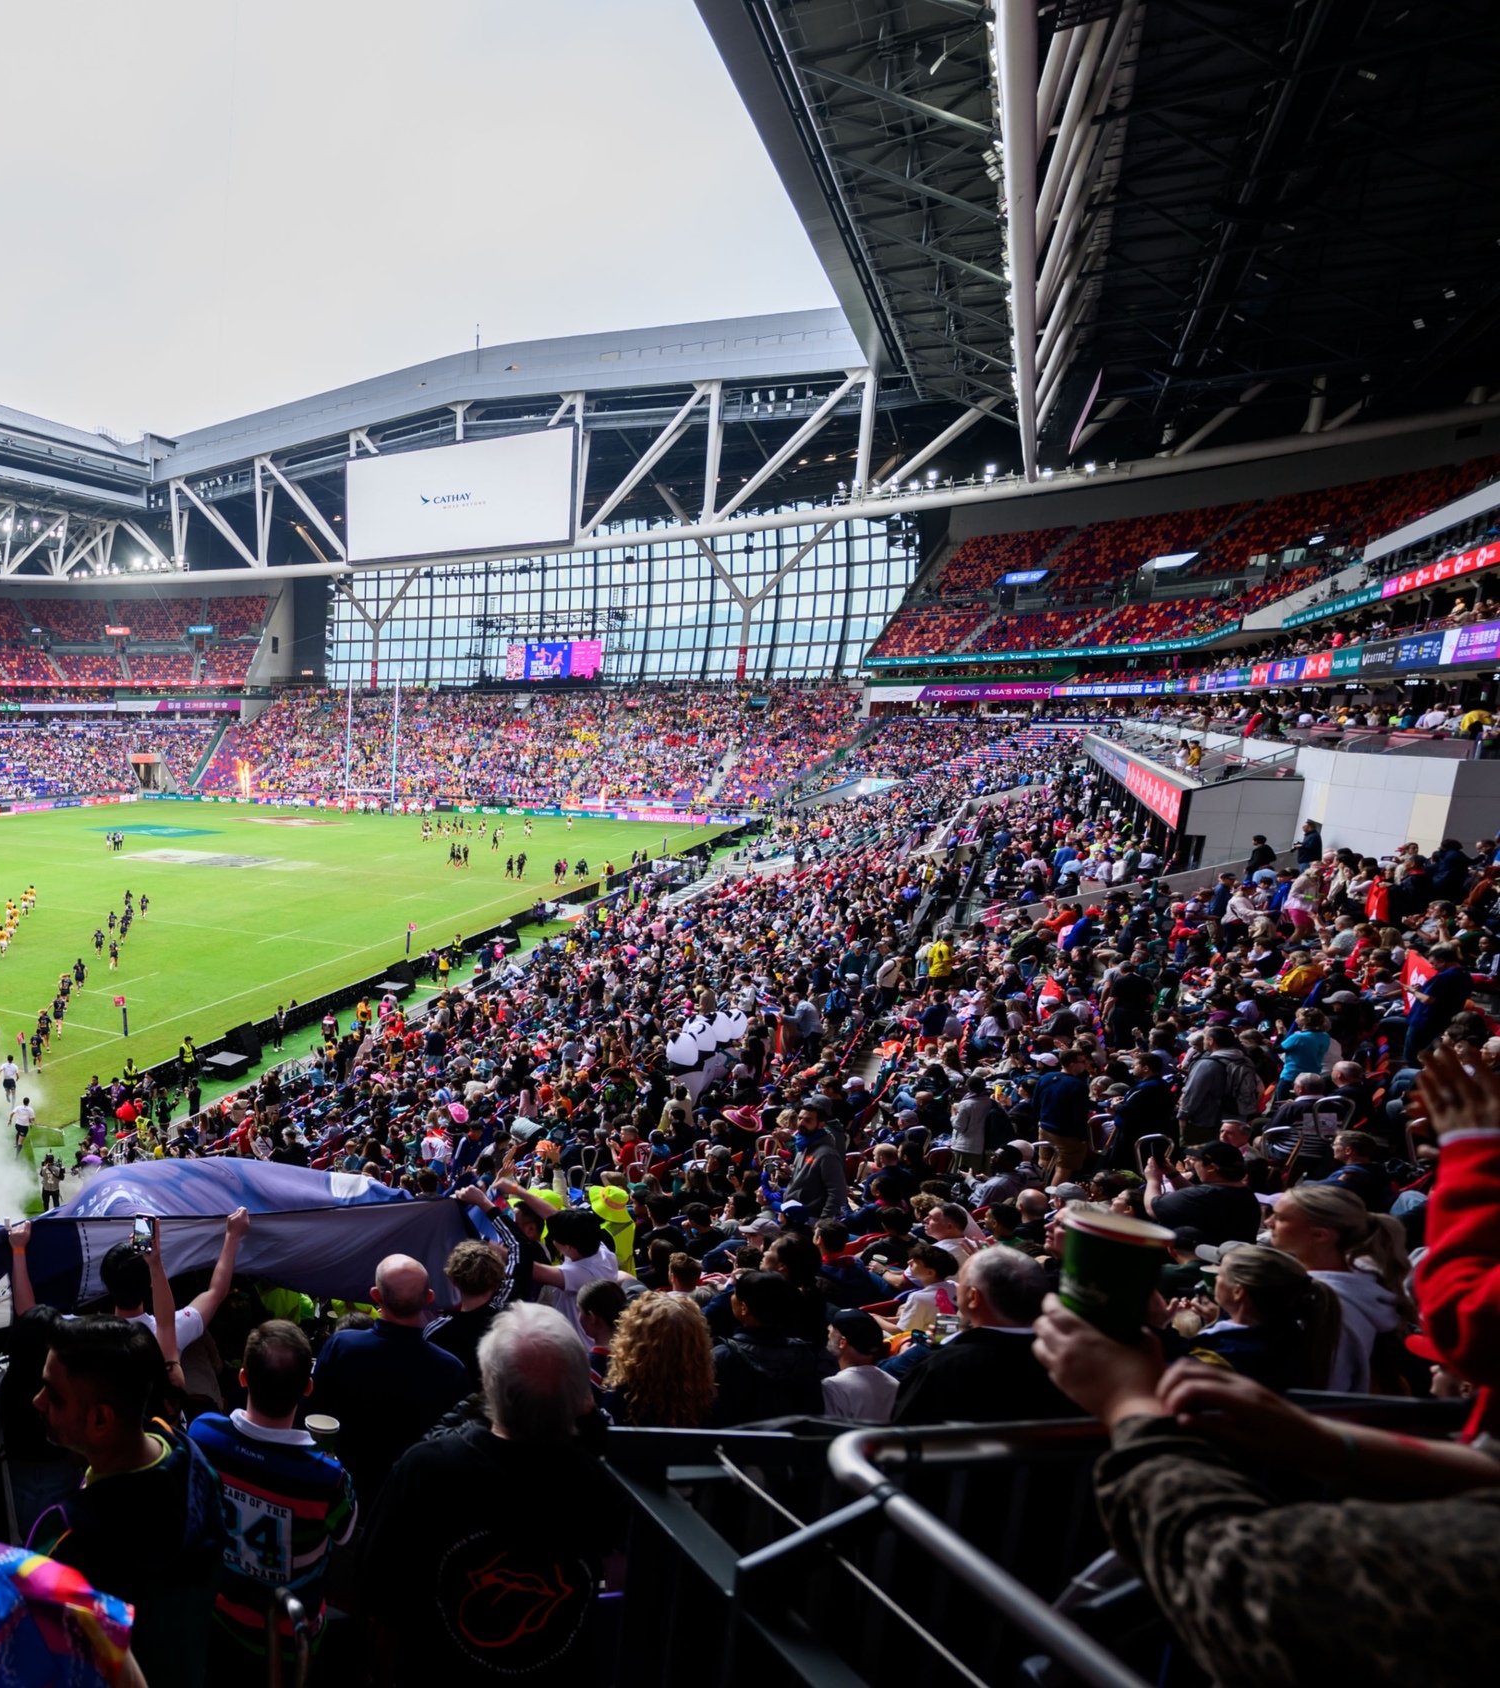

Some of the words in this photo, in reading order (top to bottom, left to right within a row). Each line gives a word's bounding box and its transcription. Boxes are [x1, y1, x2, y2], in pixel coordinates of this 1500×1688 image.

[433, 492, 472, 504] CATHAY
[638, 813, 697, 823] @SVNSSERIES
[223, 1485, 246, 1503] EARS
[249, 1496, 262, 1509] OF
[265, 1503, 287, 1519] THE
[244, 1561, 287, 1581] STAND
